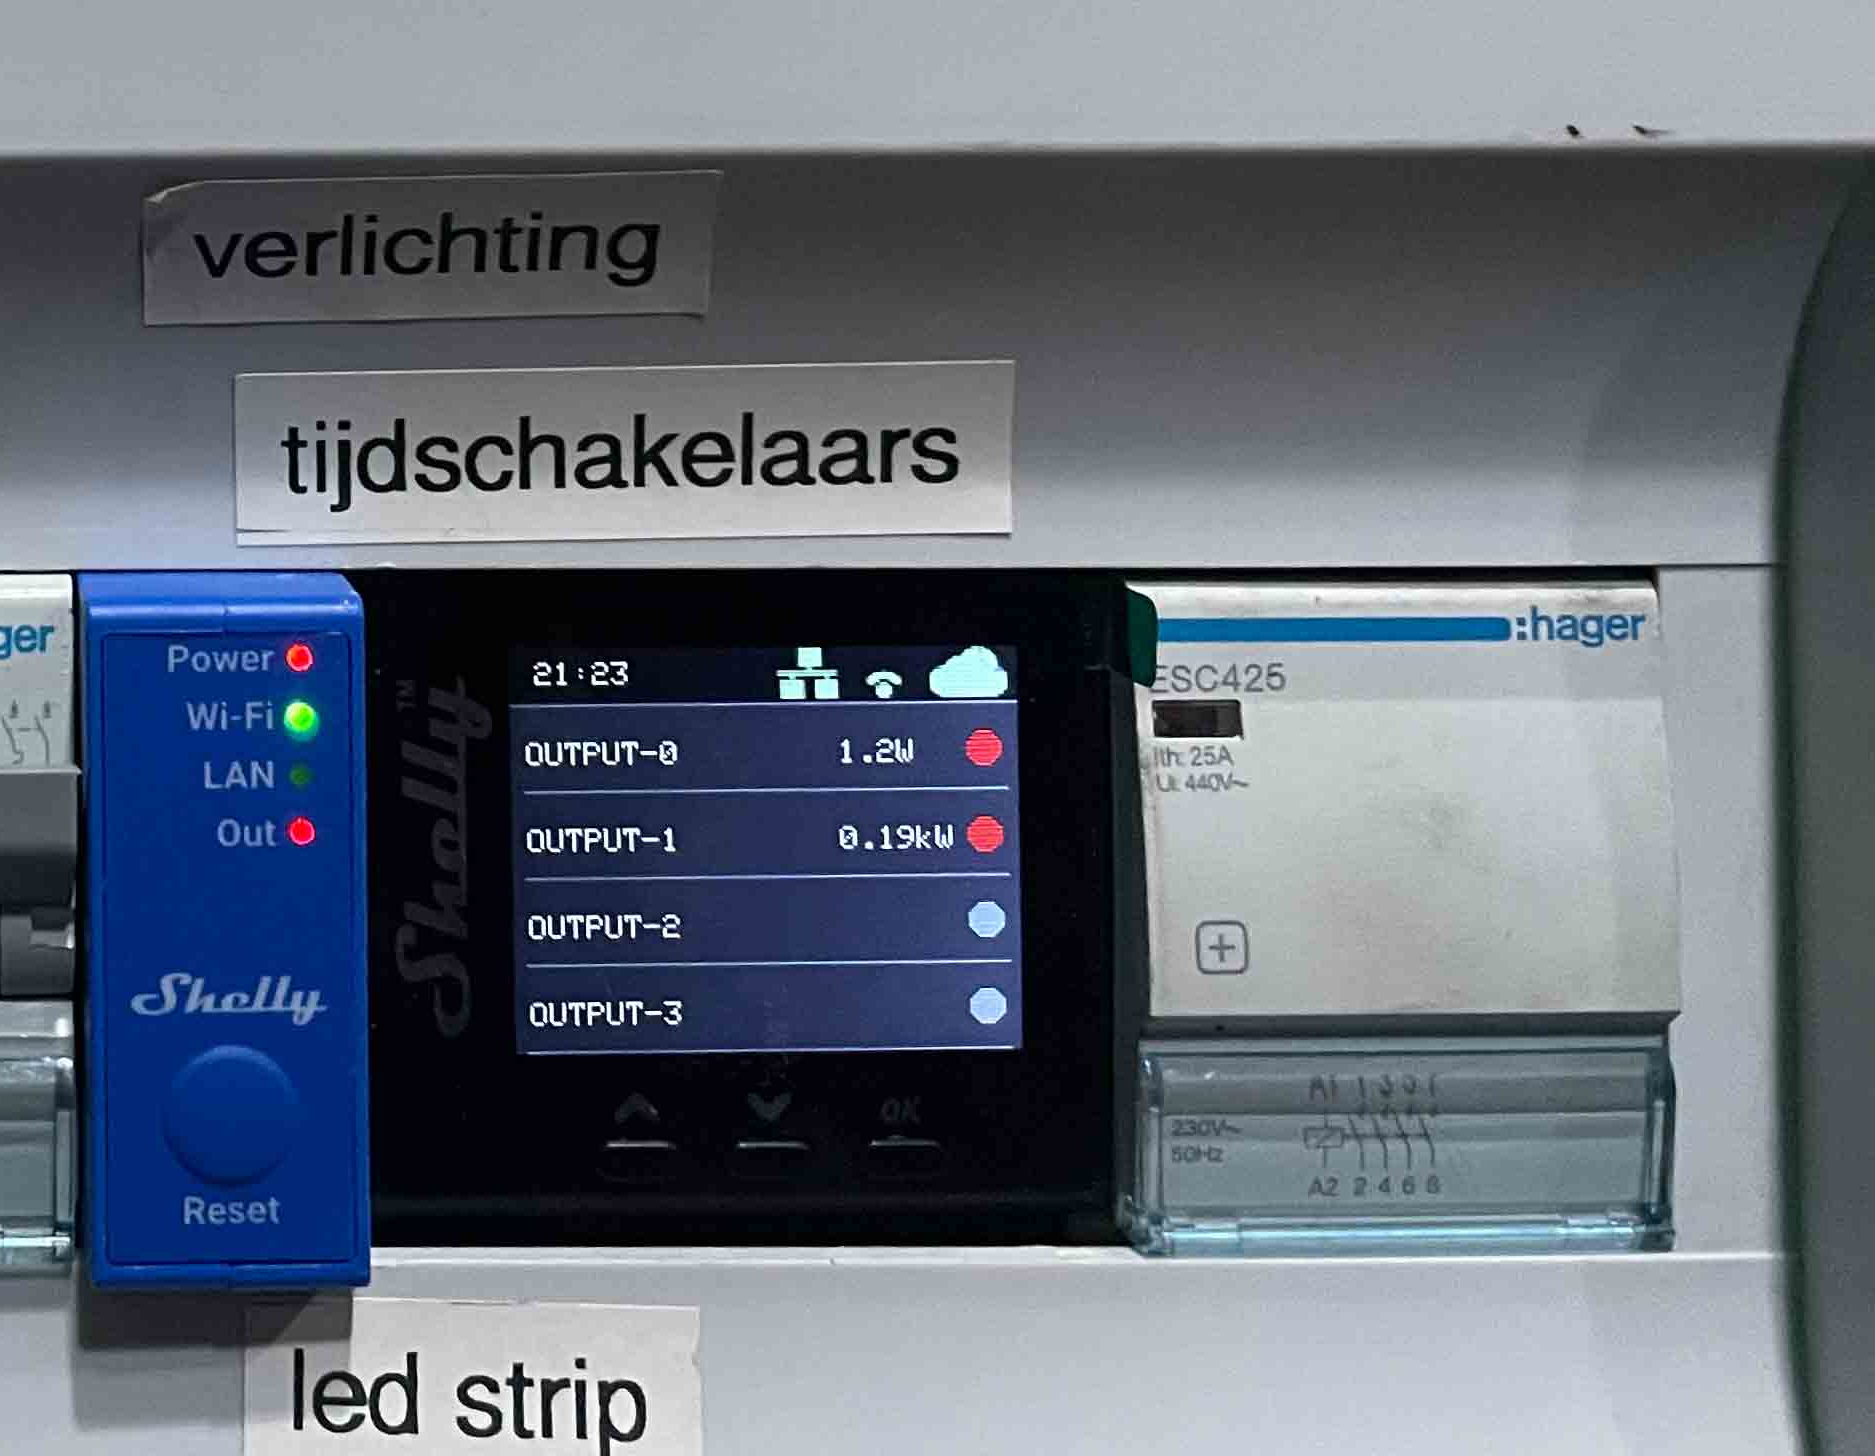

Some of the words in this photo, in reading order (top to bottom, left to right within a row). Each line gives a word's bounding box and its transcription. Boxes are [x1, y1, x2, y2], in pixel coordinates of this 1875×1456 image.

[194, 213, 661, 288] verlichting
[282, 413, 961, 511] tijdschakelaars
[168, 645, 275, 673] Power
[533, 661, 628, 686] 21:23
[1150, 662, 1286, 693] ESC425
[187, 701, 274, 731] Wi-Fi
[524, 741, 677, 767] OUTPUT-0
[839, 738, 915, 764] 1.2W
[1190, 745, 1234, 767] 25A
[204, 761, 274, 789] LAN
[217, 819, 276, 847] Out
[526, 827, 676, 853] OUTPUT-1
[838, 825, 954, 850] 0.19kW
[396, 676, 492, 1036] Shelly
[528, 914, 681, 940] OUTPUT-2
[131, 972, 327, 1026] Shelly
[529, 1001, 683, 1027] OUTPUT-3
[1308, 1176, 1340, 1197] A2
[184, 1196, 280, 1225] Reset
[294, 1348, 420, 1435] led
[455, 1357, 648, 1455] strip
